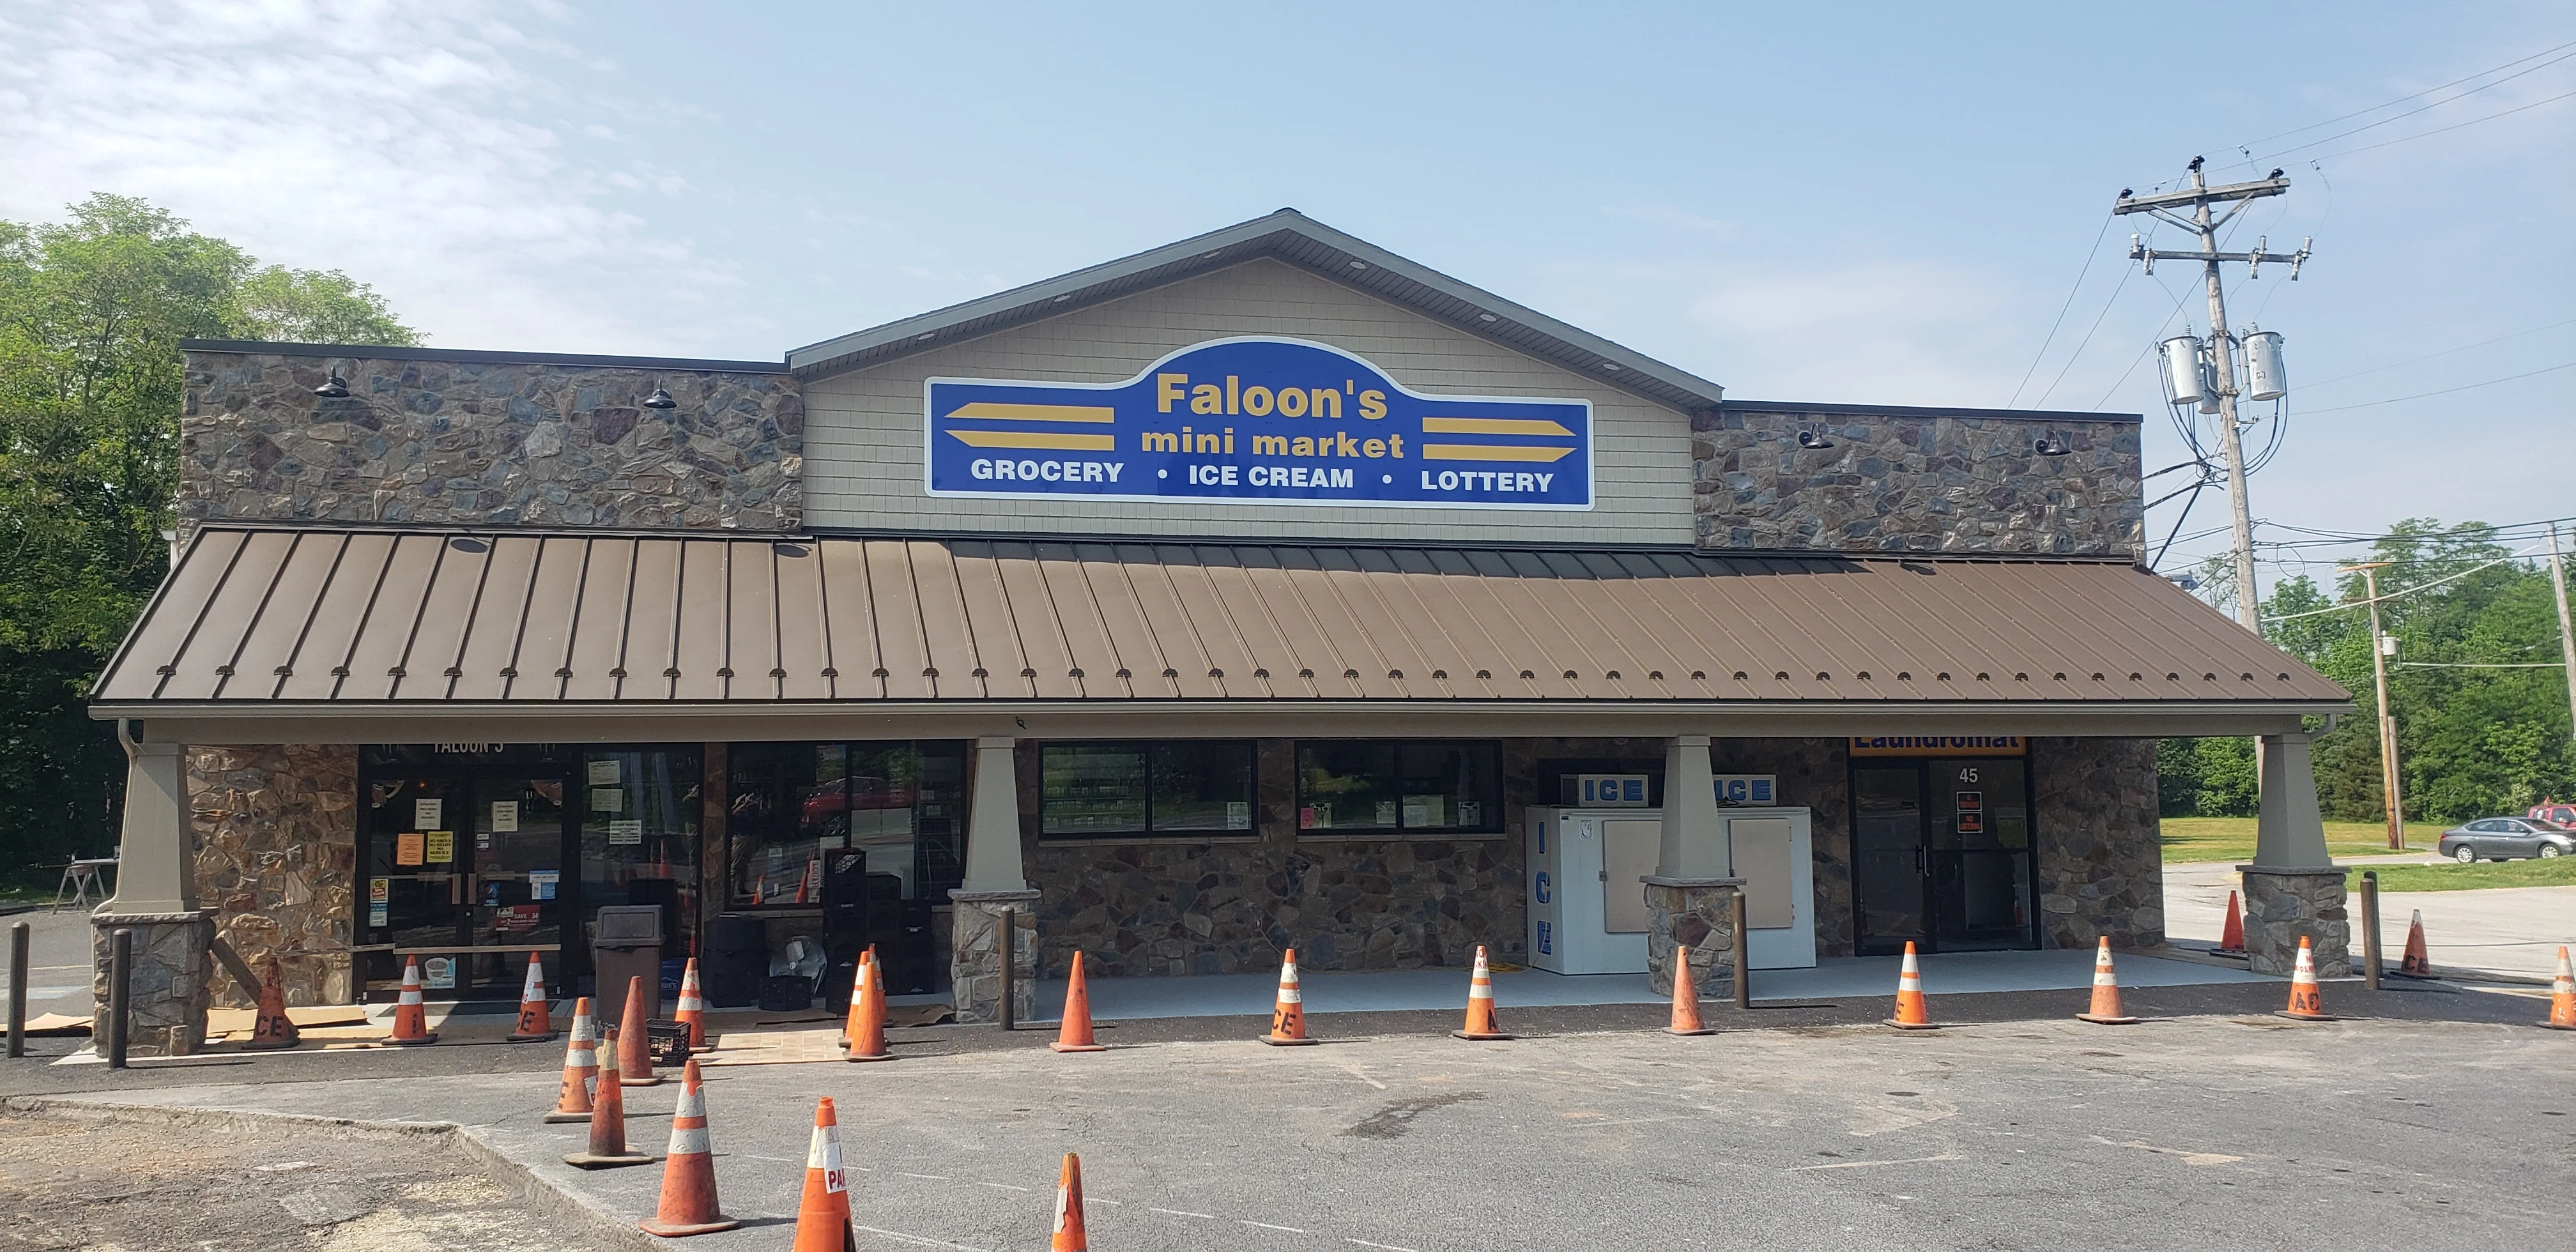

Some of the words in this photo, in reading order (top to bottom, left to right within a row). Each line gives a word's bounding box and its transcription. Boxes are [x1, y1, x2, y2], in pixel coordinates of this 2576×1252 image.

[1157, 372, 1388, 420] Faloon's
[1141, 426, 1234, 454] mini
[1252, 431, 1404, 459] market
[970, 458, 1124, 482] GROCERY
[1189, 464, 1239, 486] ICE
[1248, 466, 1354, 489] CREAM
[1421, 470, 1554, 492] LOTTERY
[434, 742, 503, 753] FALOONS
[1959, 768, 1978, 783] 45
[1584, 779, 1644, 801] ICE
[1714, 779, 1772, 801] ICE
[256, 1015, 283, 1037] CE
